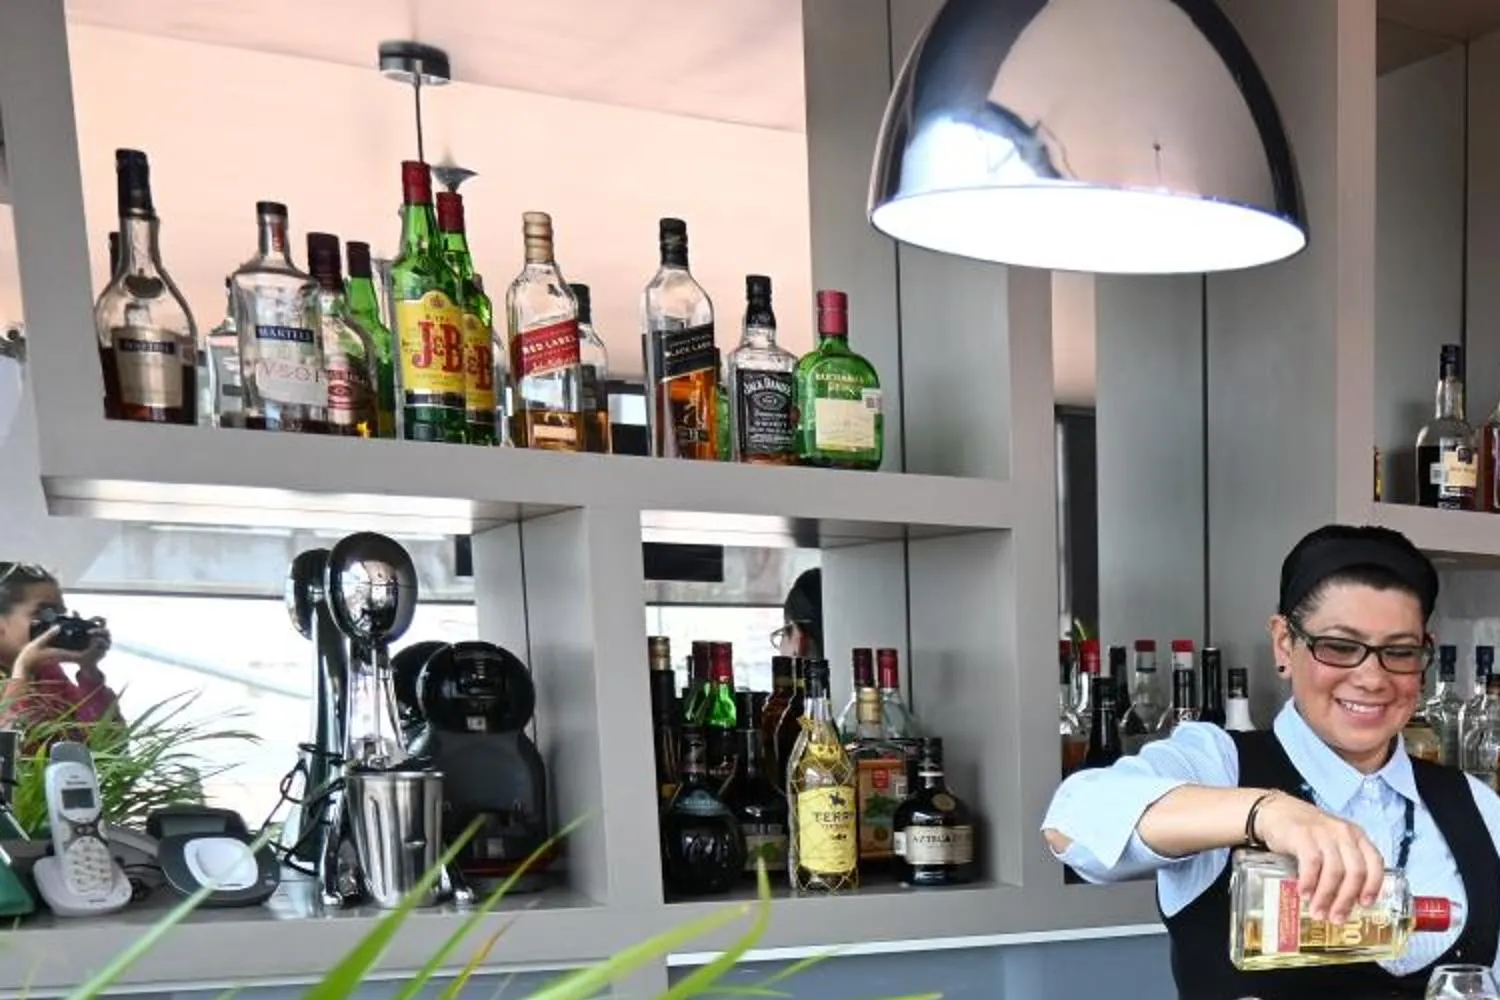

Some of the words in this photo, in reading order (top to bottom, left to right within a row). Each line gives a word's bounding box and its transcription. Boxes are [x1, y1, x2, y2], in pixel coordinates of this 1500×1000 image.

[257, 327, 312, 341] MARTELL
[412, 320, 463, 373] J&B
[521, 341, 544, 355] RED
